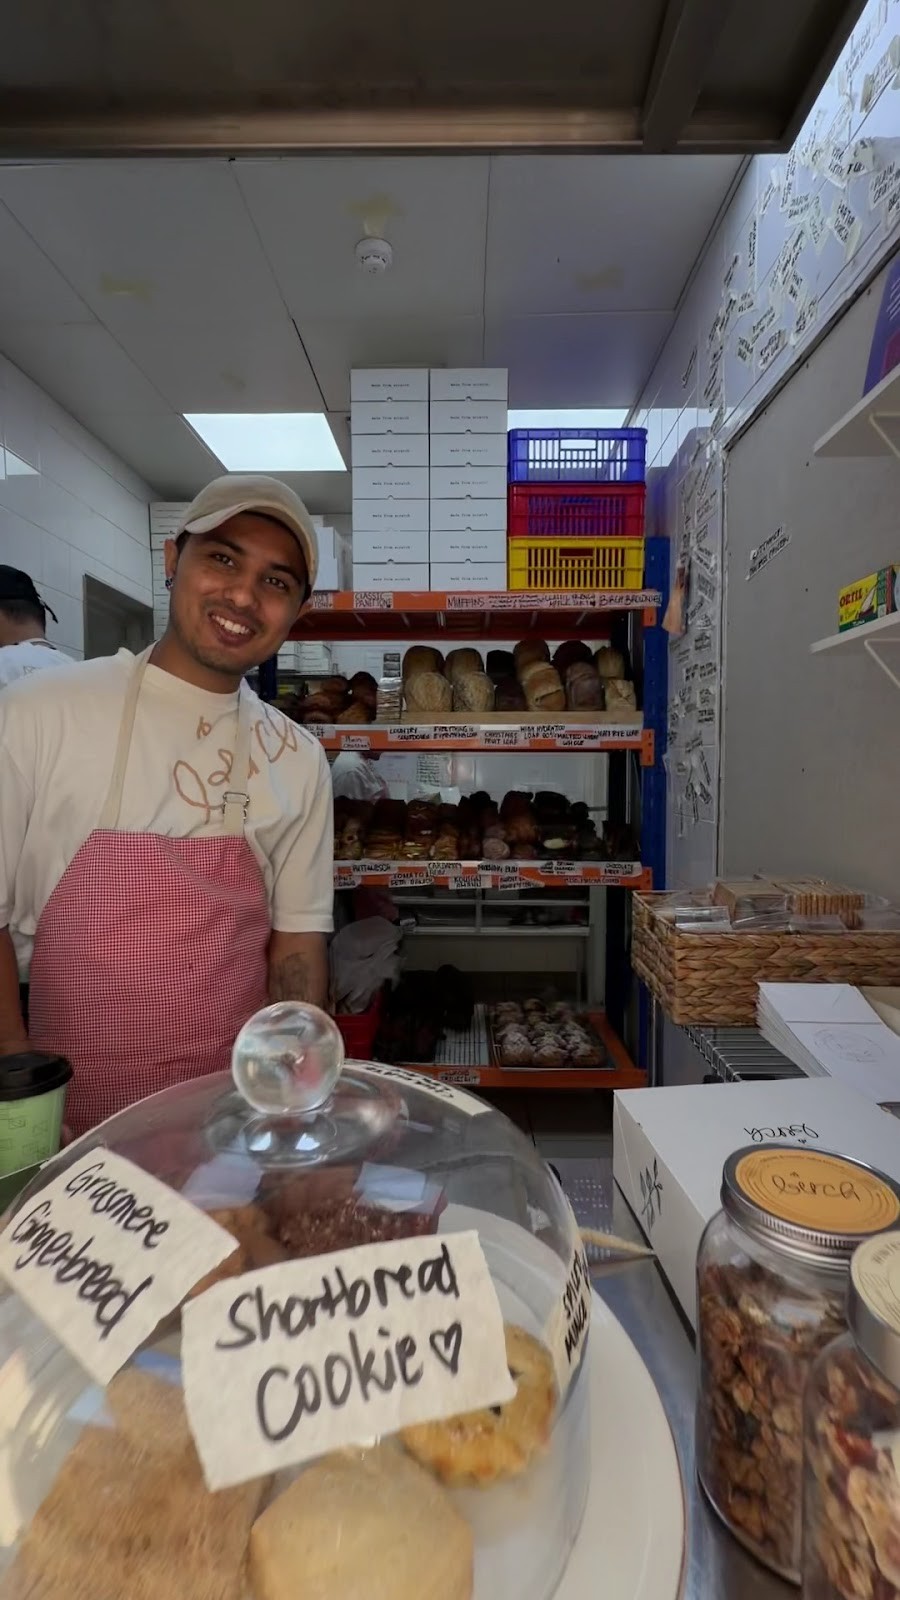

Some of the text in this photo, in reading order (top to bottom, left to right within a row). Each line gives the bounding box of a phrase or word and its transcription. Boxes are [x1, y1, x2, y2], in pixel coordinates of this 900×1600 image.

[447, 596, 486, 608] MUFFINS
[64, 1161, 170, 1248] Grasmere
[9, 1201, 152, 1340] Gingerbread
[216, 1243, 461, 1348] Shortbread
[256, 1329, 424, 1442] Cookie
